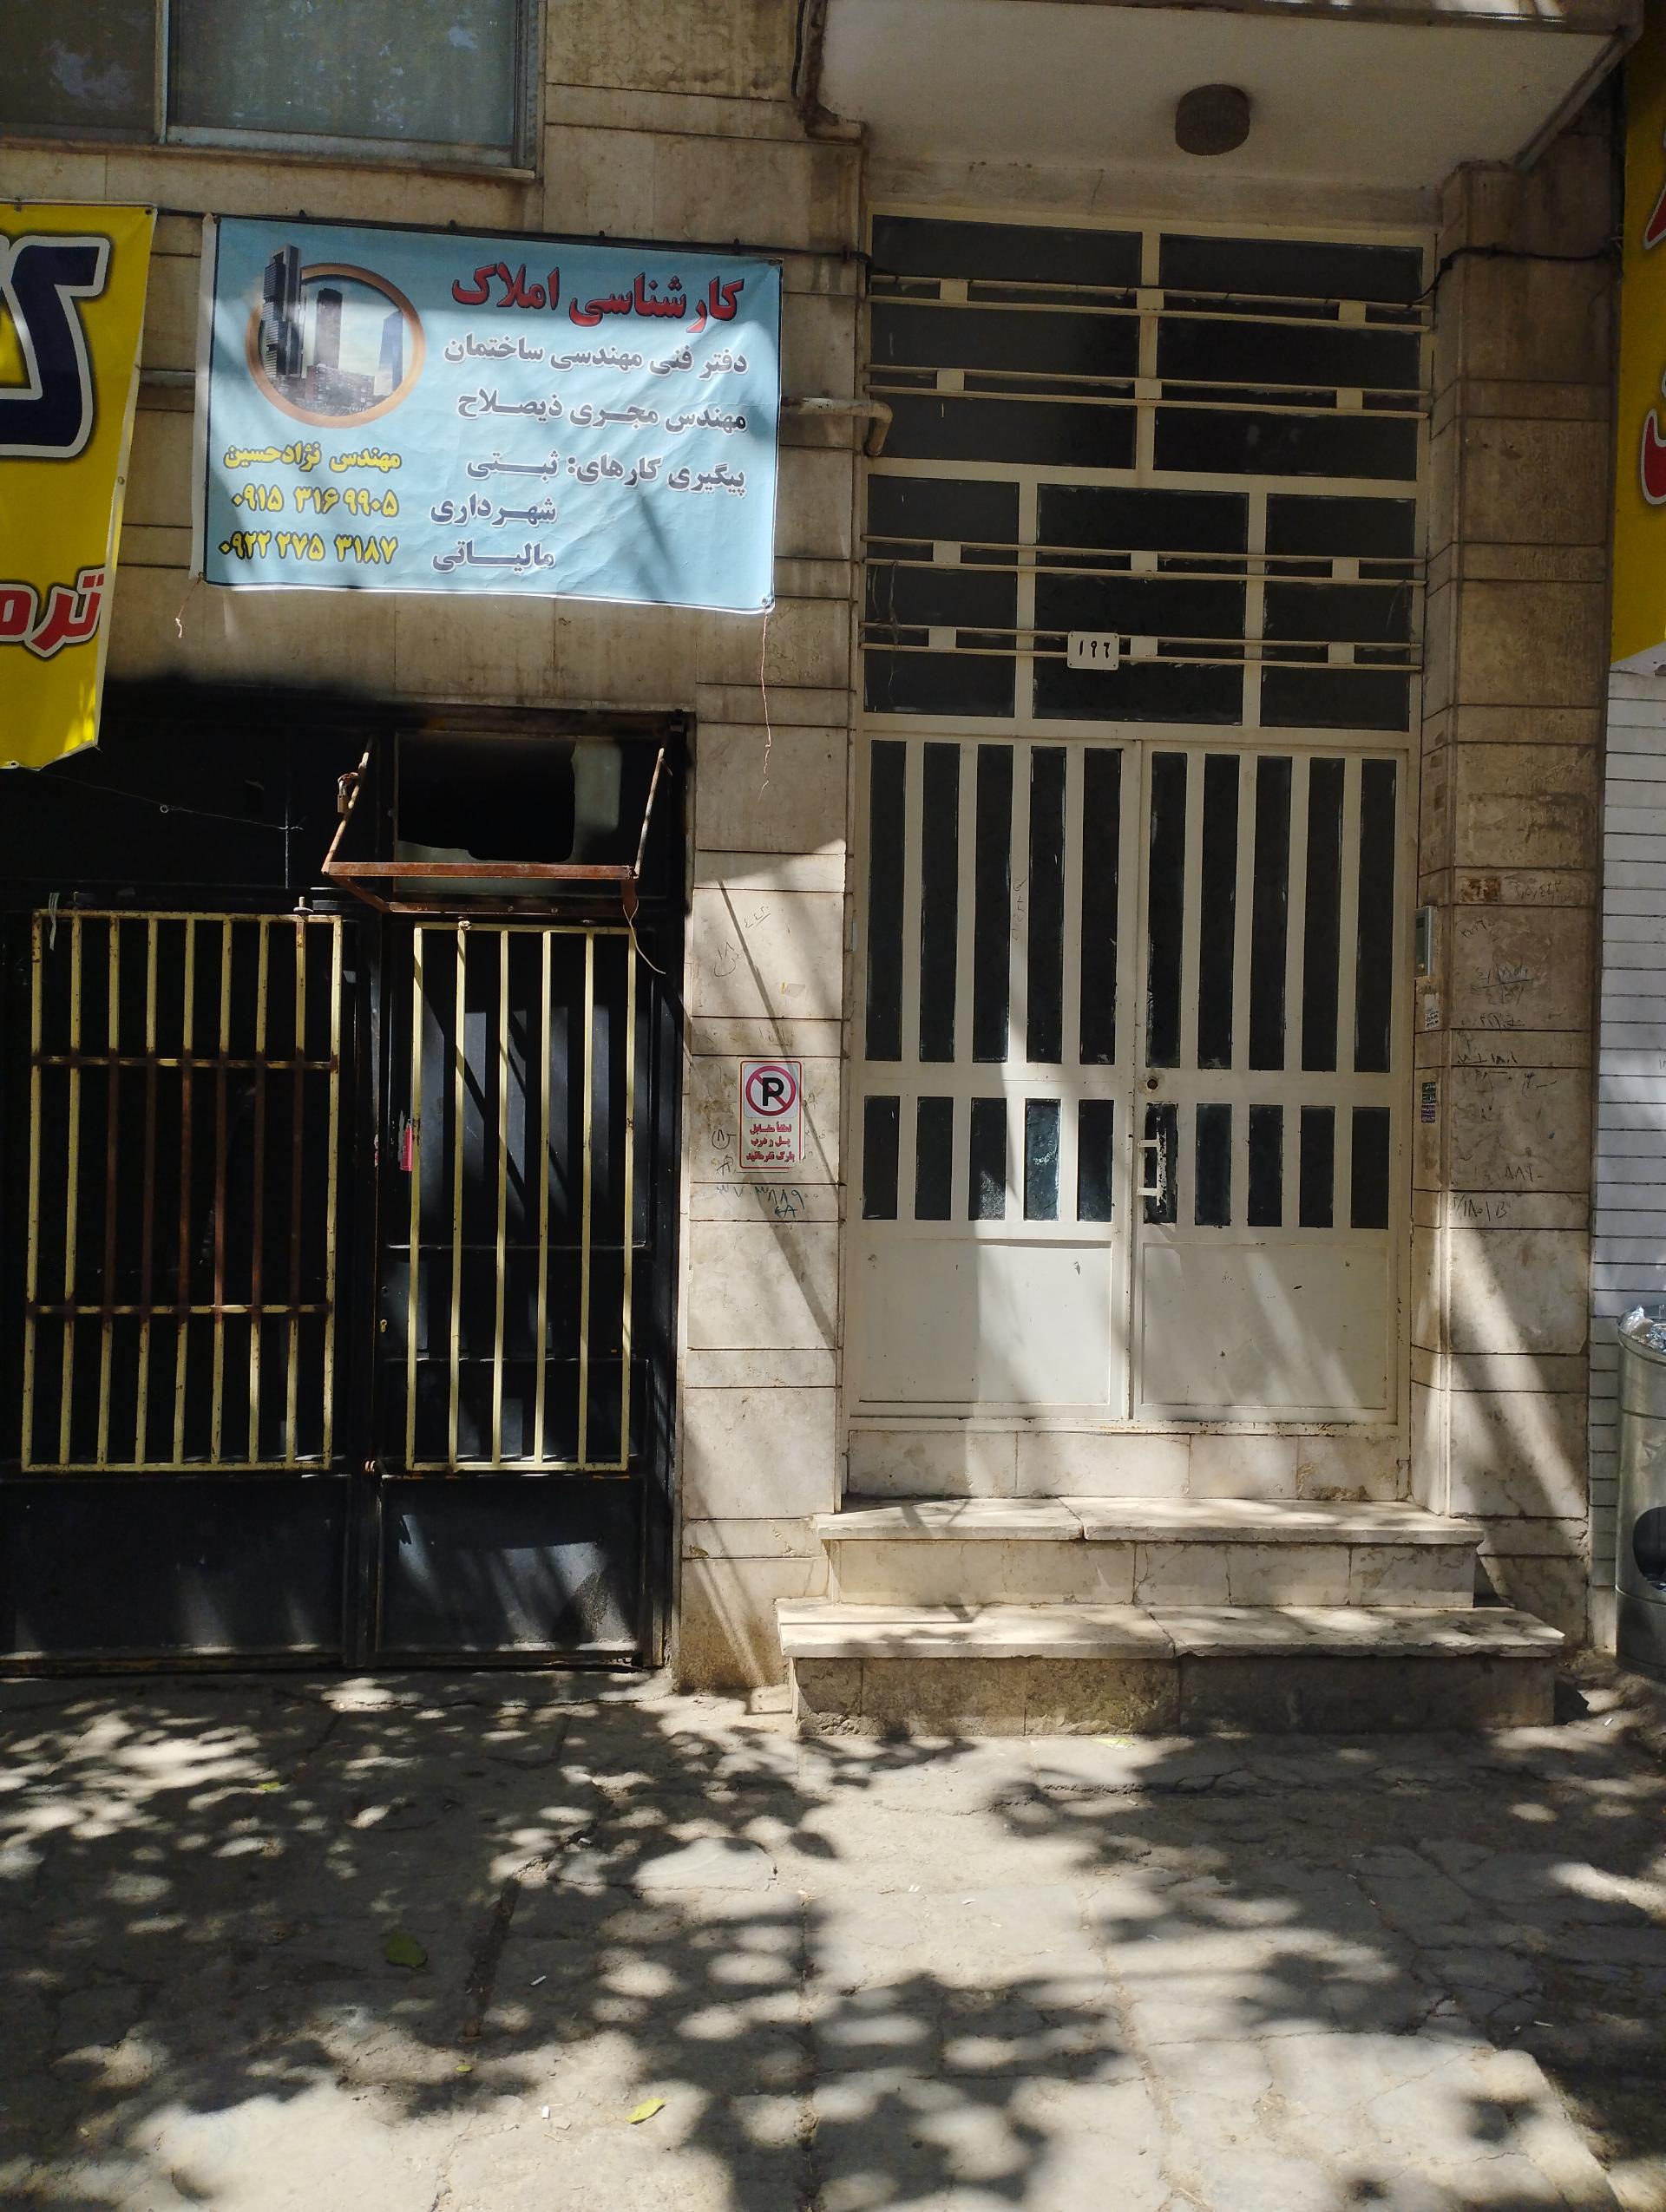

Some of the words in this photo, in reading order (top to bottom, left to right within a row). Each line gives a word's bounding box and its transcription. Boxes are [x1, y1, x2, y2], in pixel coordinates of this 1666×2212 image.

[451, 261, 561, 311] املاک
[568, 272, 744, 334] کارشناسی
[443, 332, 544, 364] ساختمان
[550, 345, 644, 373] مهندسی
[649, 343, 693, 377] فنی
[698, 347, 749, 380] دفتر
[456, 387, 564, 423] ذیصلاح
[568, 401, 660, 430] مجری
[665, 406, 749, 436] مهندس
[329, 448, 402, 473] مهندس
[466, 449, 560, 483] ثبتی
[666, 462, 747, 497] پیگیری
[231, 483, 285, 513] ۰۹۱۵
[292, 485, 340, 514] ۳۱۶
[343, 487, 400, 518] ۹۹۰۵
[430, 492, 558, 527] شهرداری
[218, 529, 272, 560] ۰۹۲۲
[275, 530, 326, 562] ۲۷۵
[333, 533, 399, 565] ۳۱۸۷
[432, 540, 557, 575] مالیاتی
[763, 1077, 784, 1106] P
